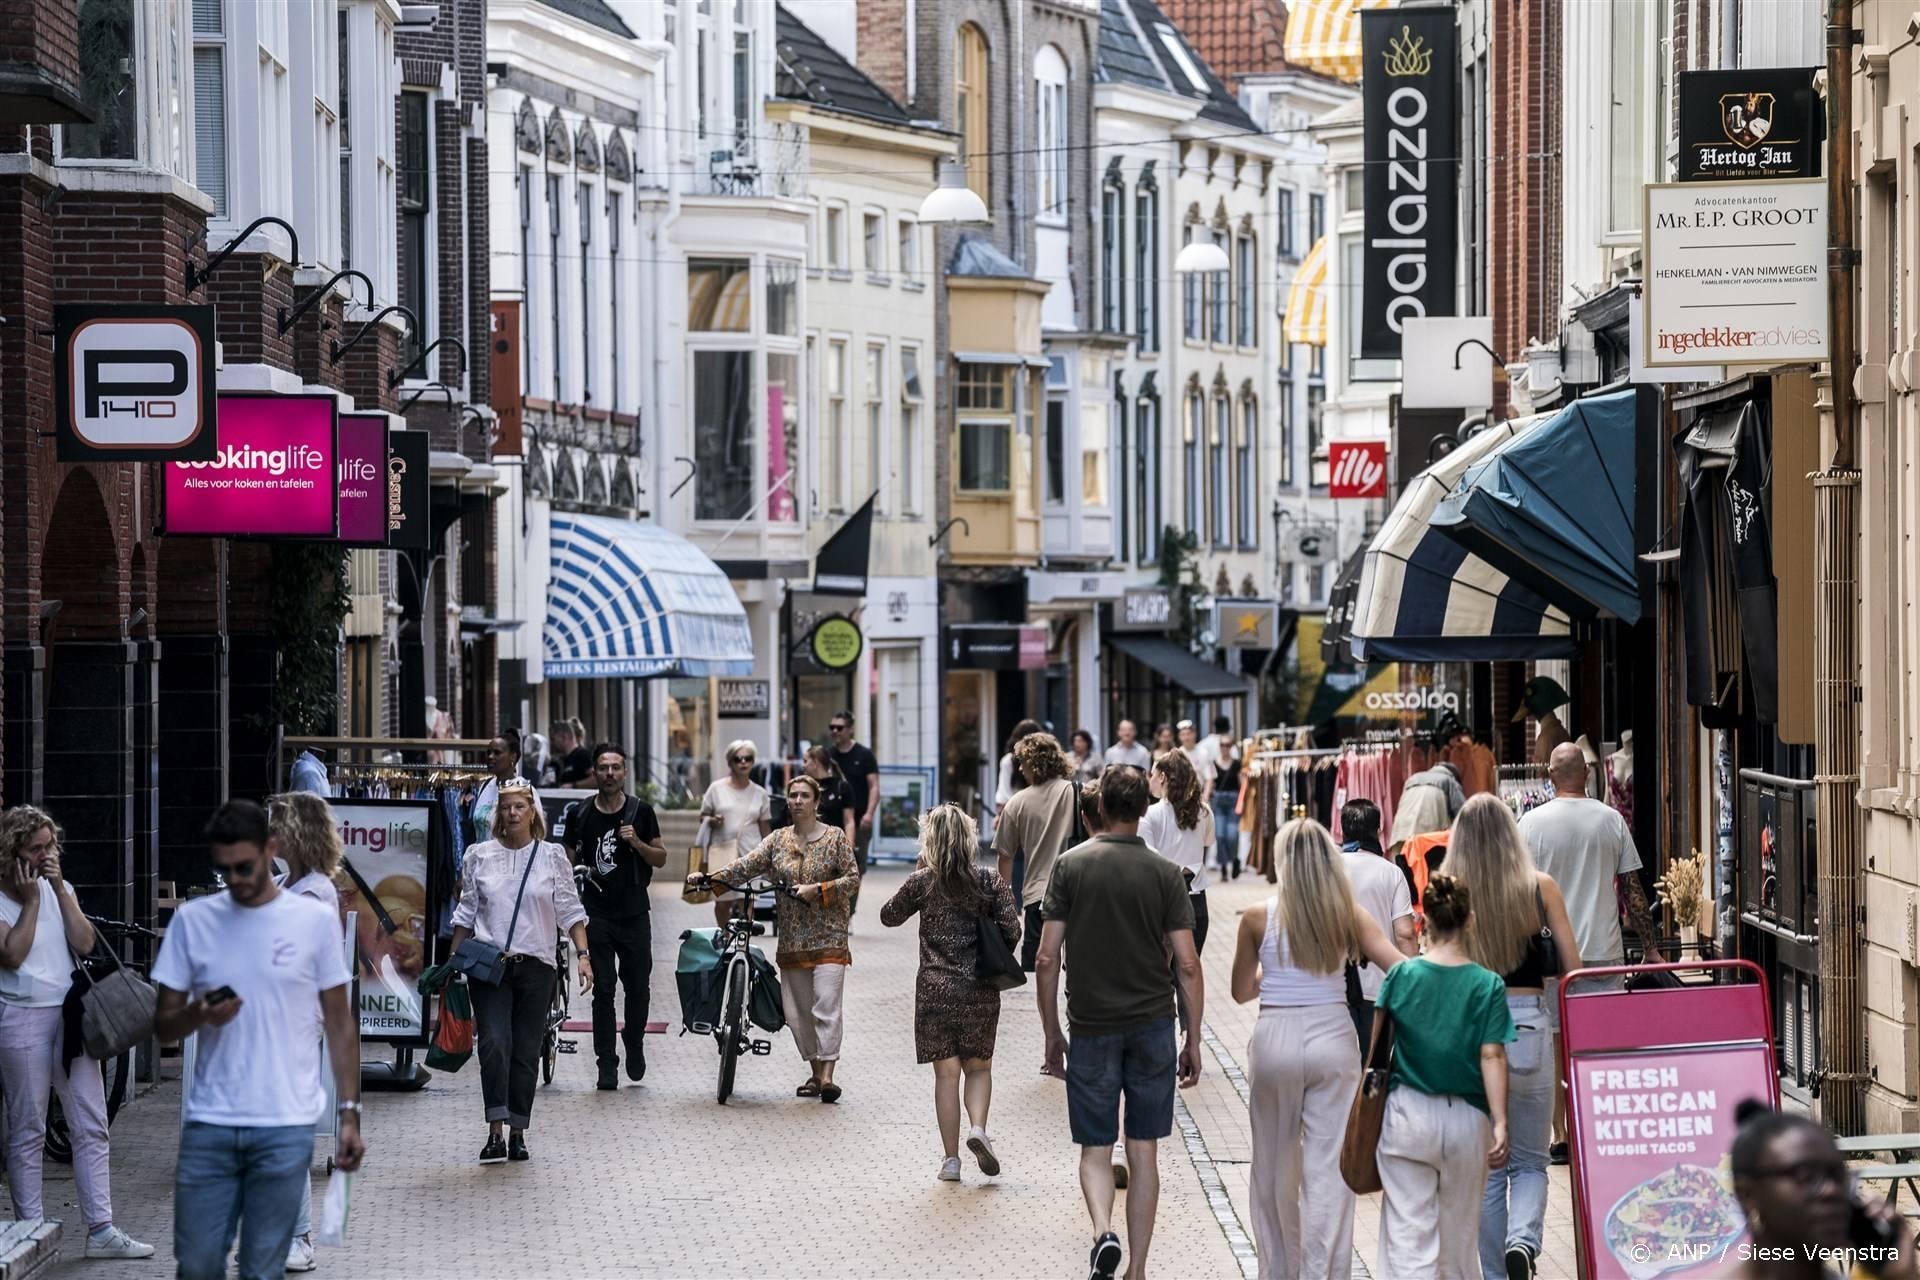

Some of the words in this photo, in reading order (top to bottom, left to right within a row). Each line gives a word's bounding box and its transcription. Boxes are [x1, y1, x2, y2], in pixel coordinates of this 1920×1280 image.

[1700, 148, 1757, 170] Hertog
[1759, 147, 1793, 168] Jan
[1695, 196, 1778, 206] Advocatenkantoor
[1695, 211, 1727, 228] E.P.
[1732, 208, 1819, 226] GROOT
[1656, 268, 1722, 279] HENKELMAN
[1731, 267, 1754, 276] VAN
[1757, 265, 1818, 275] NIMWEGEN
[176, 444, 323, 475] okinglife
[339, 458, 376, 483] life
[1332, 447, 1384, 494] illy
[184, 478, 209, 488] Alles
[210, 480, 233, 488] voor
[234, 478, 264, 488] koken
[266, 480, 278, 488] en
[280, 478, 314, 488] tafelen
[389, 457, 407, 529] Casuals
[594, 659, 680, 673] RESTAURANT
[360, 1017, 411, 1029] PIREERD
[1590, 1067, 1679, 1090] FRESH
[1592, 1090, 1717, 1115] MEXICAN
[1595, 1115, 1713, 1140] KITCHEN
[1597, 1144, 1648, 1156] VEGGIE
[1650, 1141, 1696, 1154] TACOS
